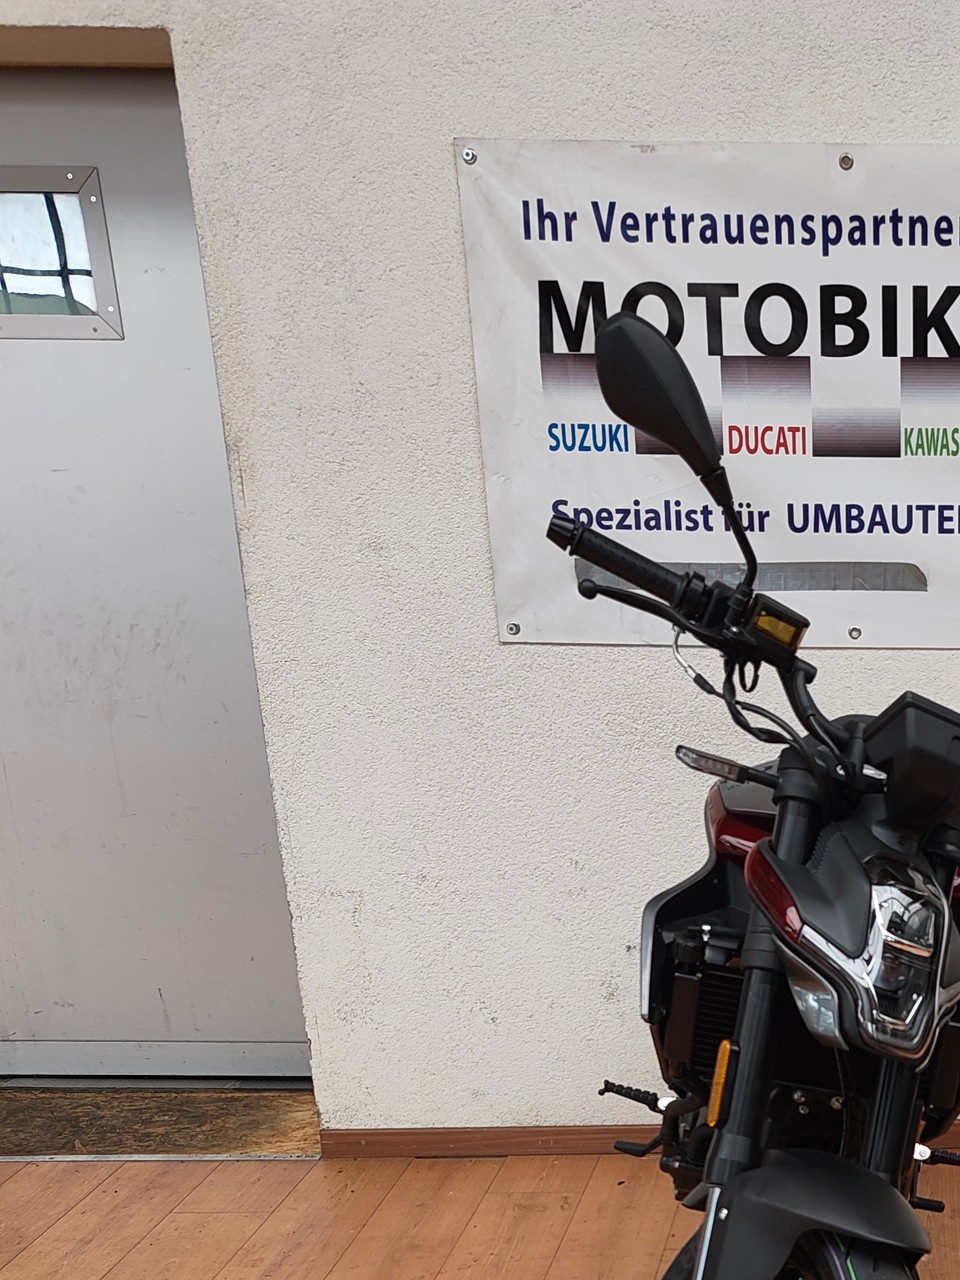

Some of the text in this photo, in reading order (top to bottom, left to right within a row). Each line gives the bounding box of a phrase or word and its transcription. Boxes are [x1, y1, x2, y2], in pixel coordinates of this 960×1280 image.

[521, 197, 578, 243] Ihr
[547, 423, 630, 454] SUZUKI
[727, 424, 807, 456] DUCATI
